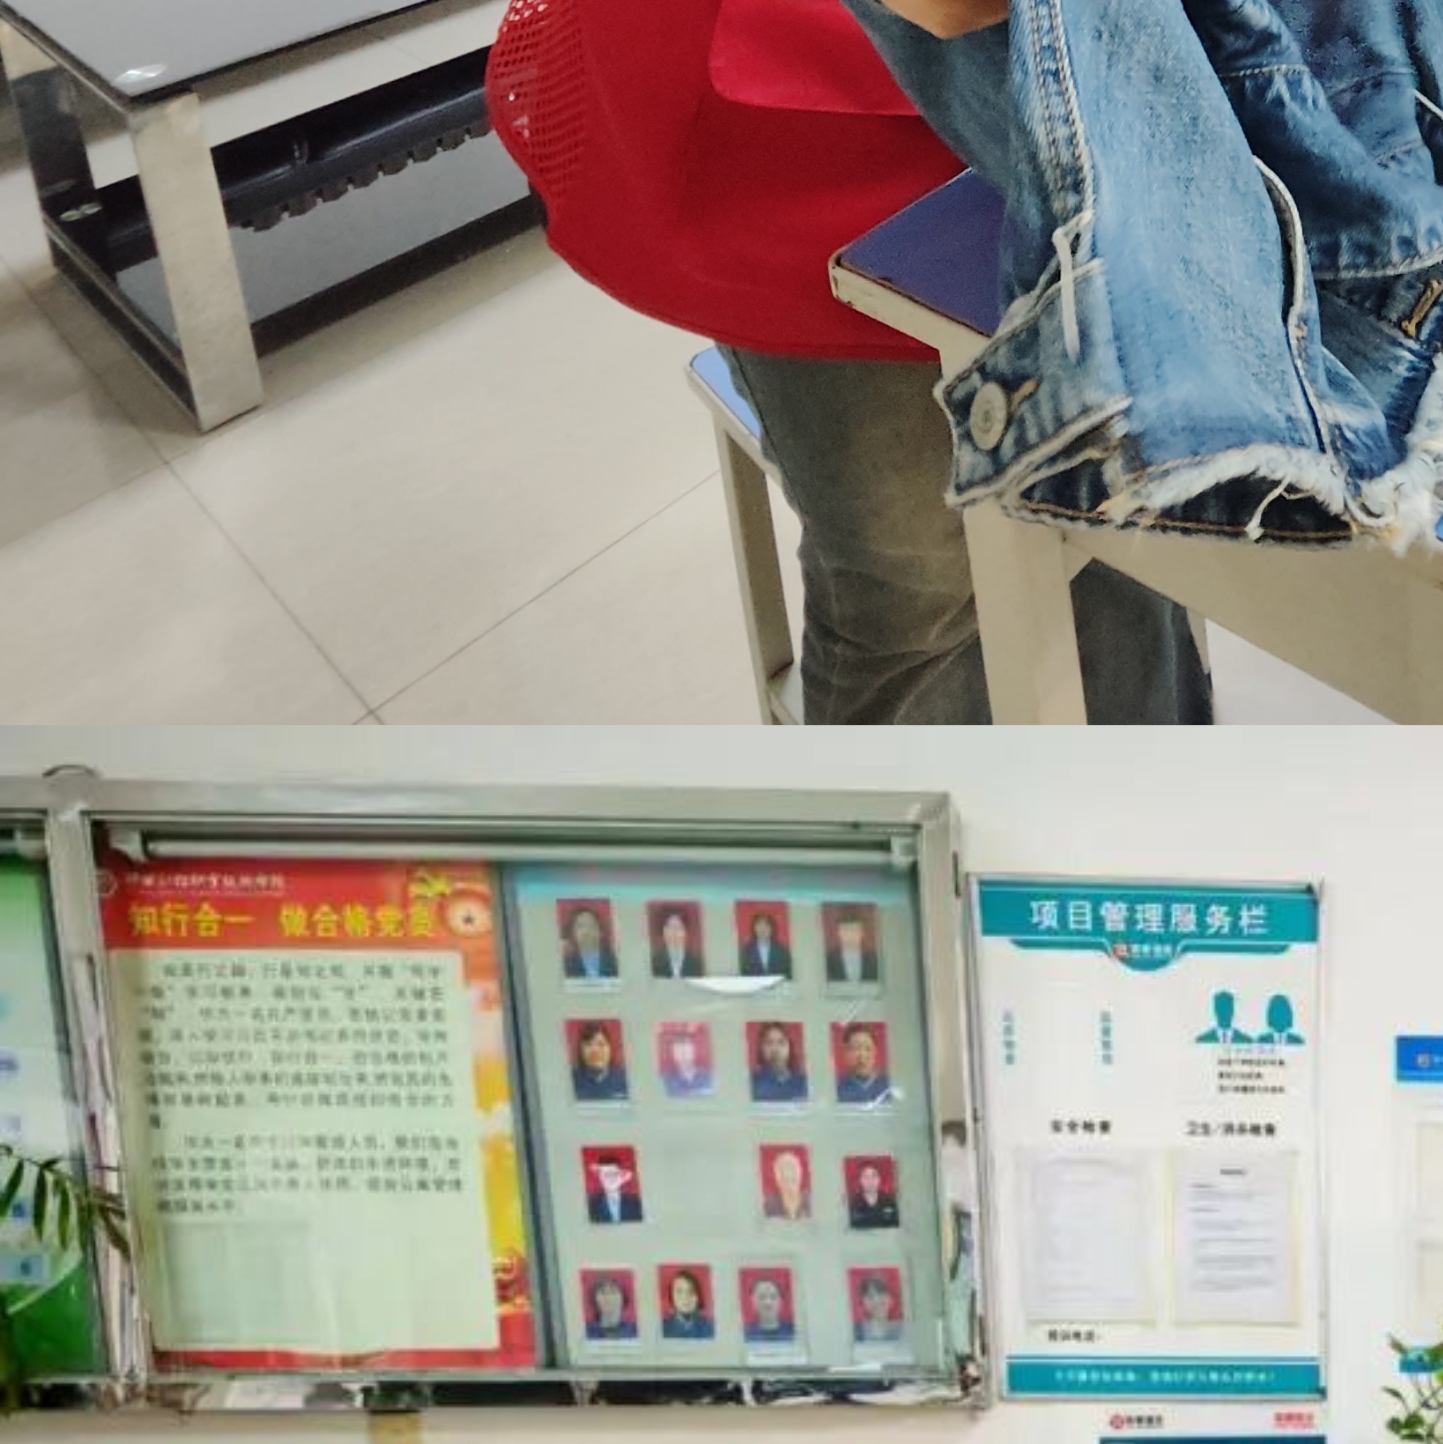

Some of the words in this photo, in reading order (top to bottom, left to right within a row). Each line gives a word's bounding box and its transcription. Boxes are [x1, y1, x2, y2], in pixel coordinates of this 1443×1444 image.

[128, 901, 257, 938] 知行合一
[1029, 899, 1269, 936] 项目管理服务栏
